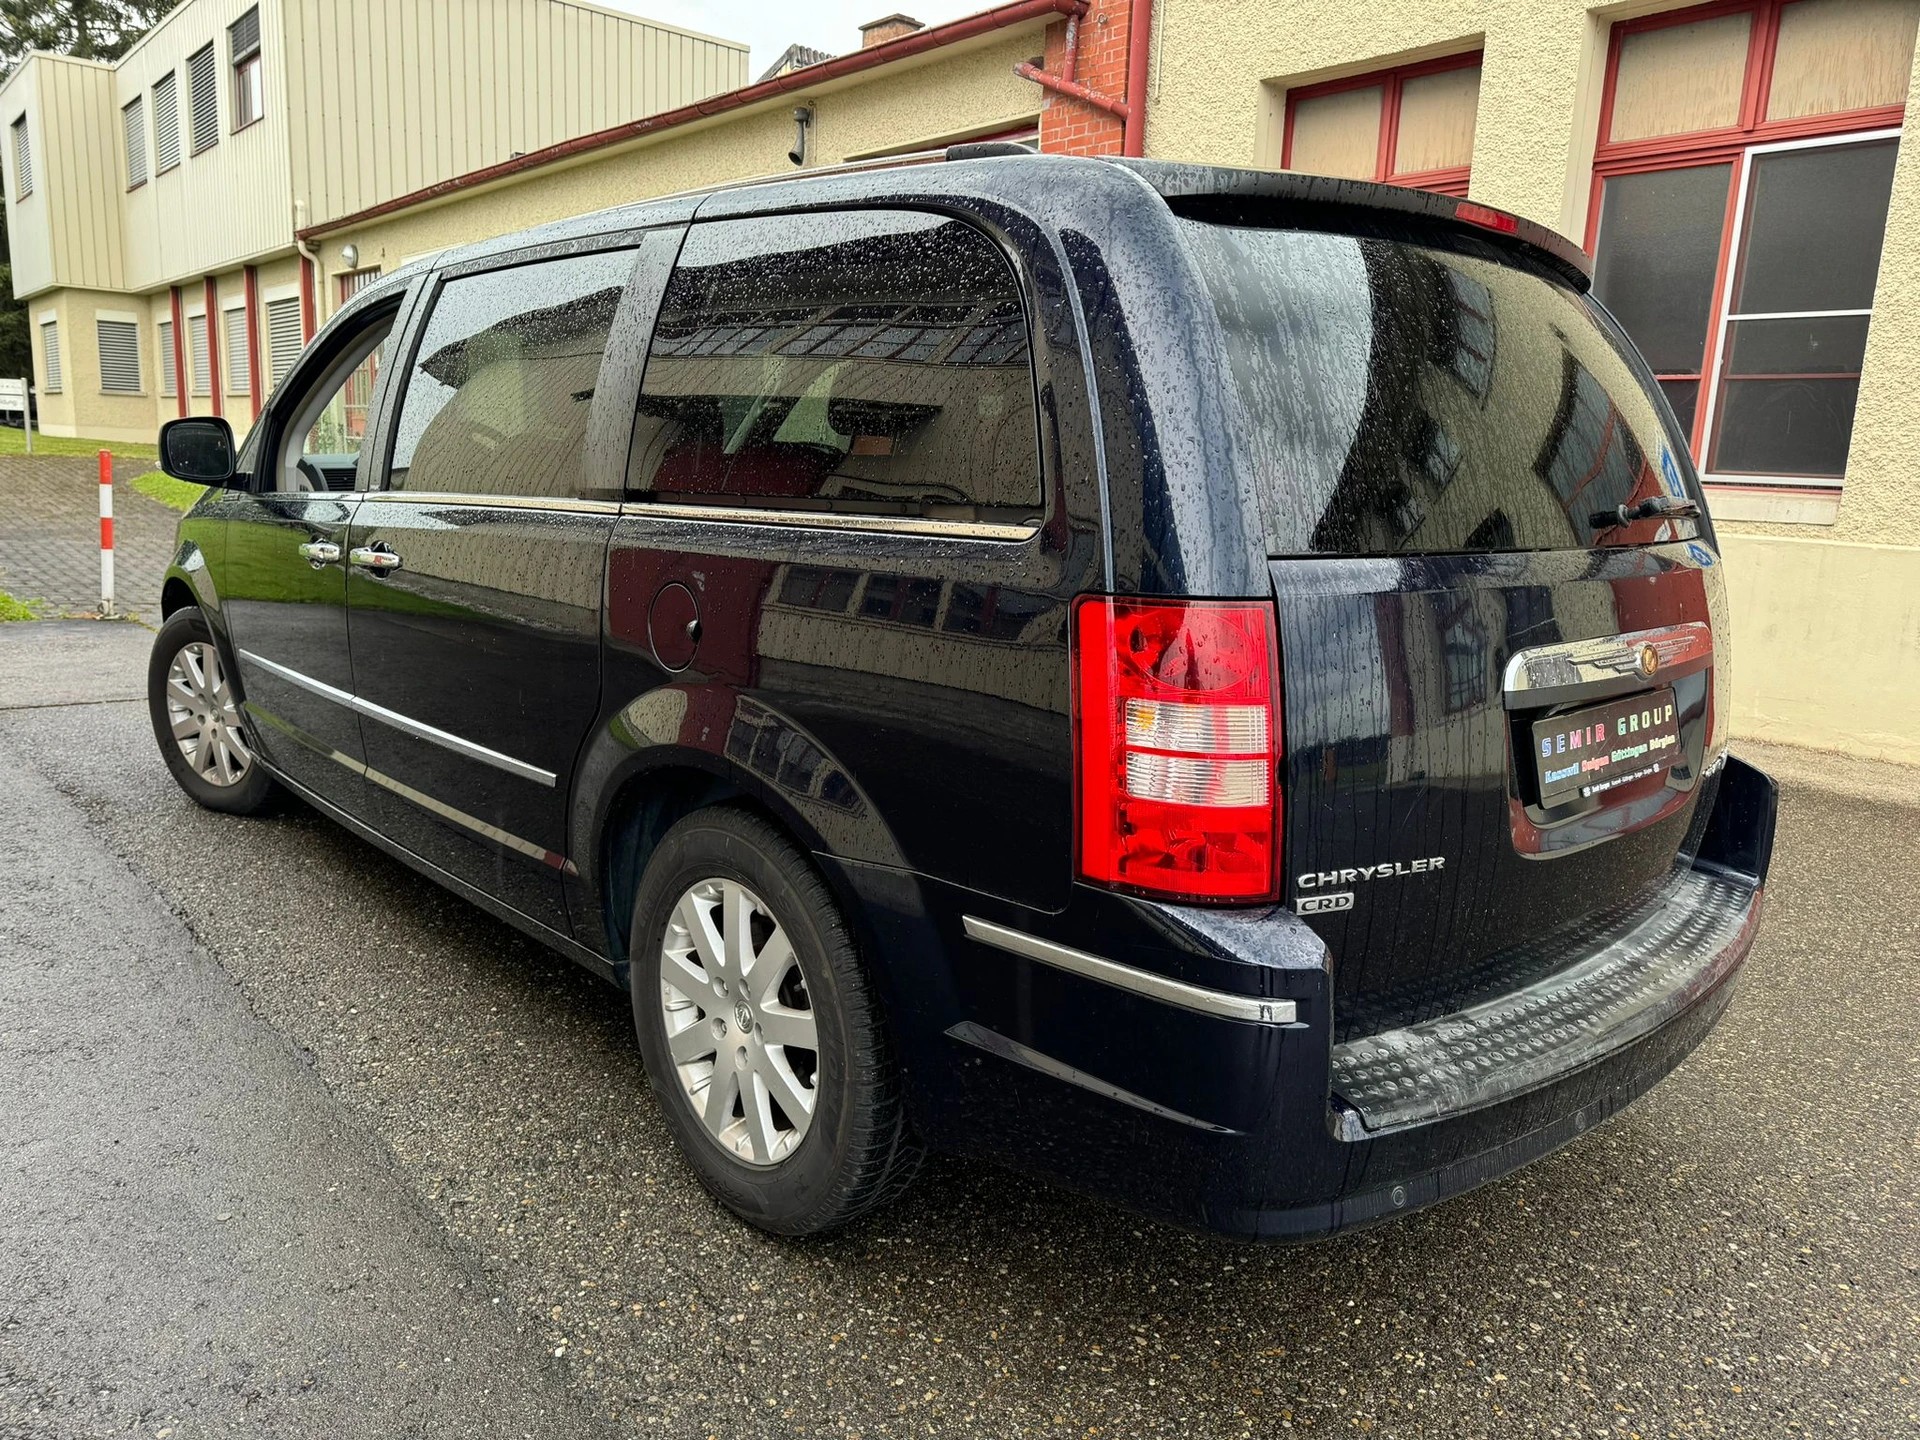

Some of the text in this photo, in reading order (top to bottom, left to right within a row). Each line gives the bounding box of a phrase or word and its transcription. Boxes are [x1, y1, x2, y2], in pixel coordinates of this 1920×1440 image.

[1541, 704, 1673, 758] SEMIR GROUP
[1297, 856, 1446, 889] CHRYSLER
[1301, 896, 1350, 912] CRD
